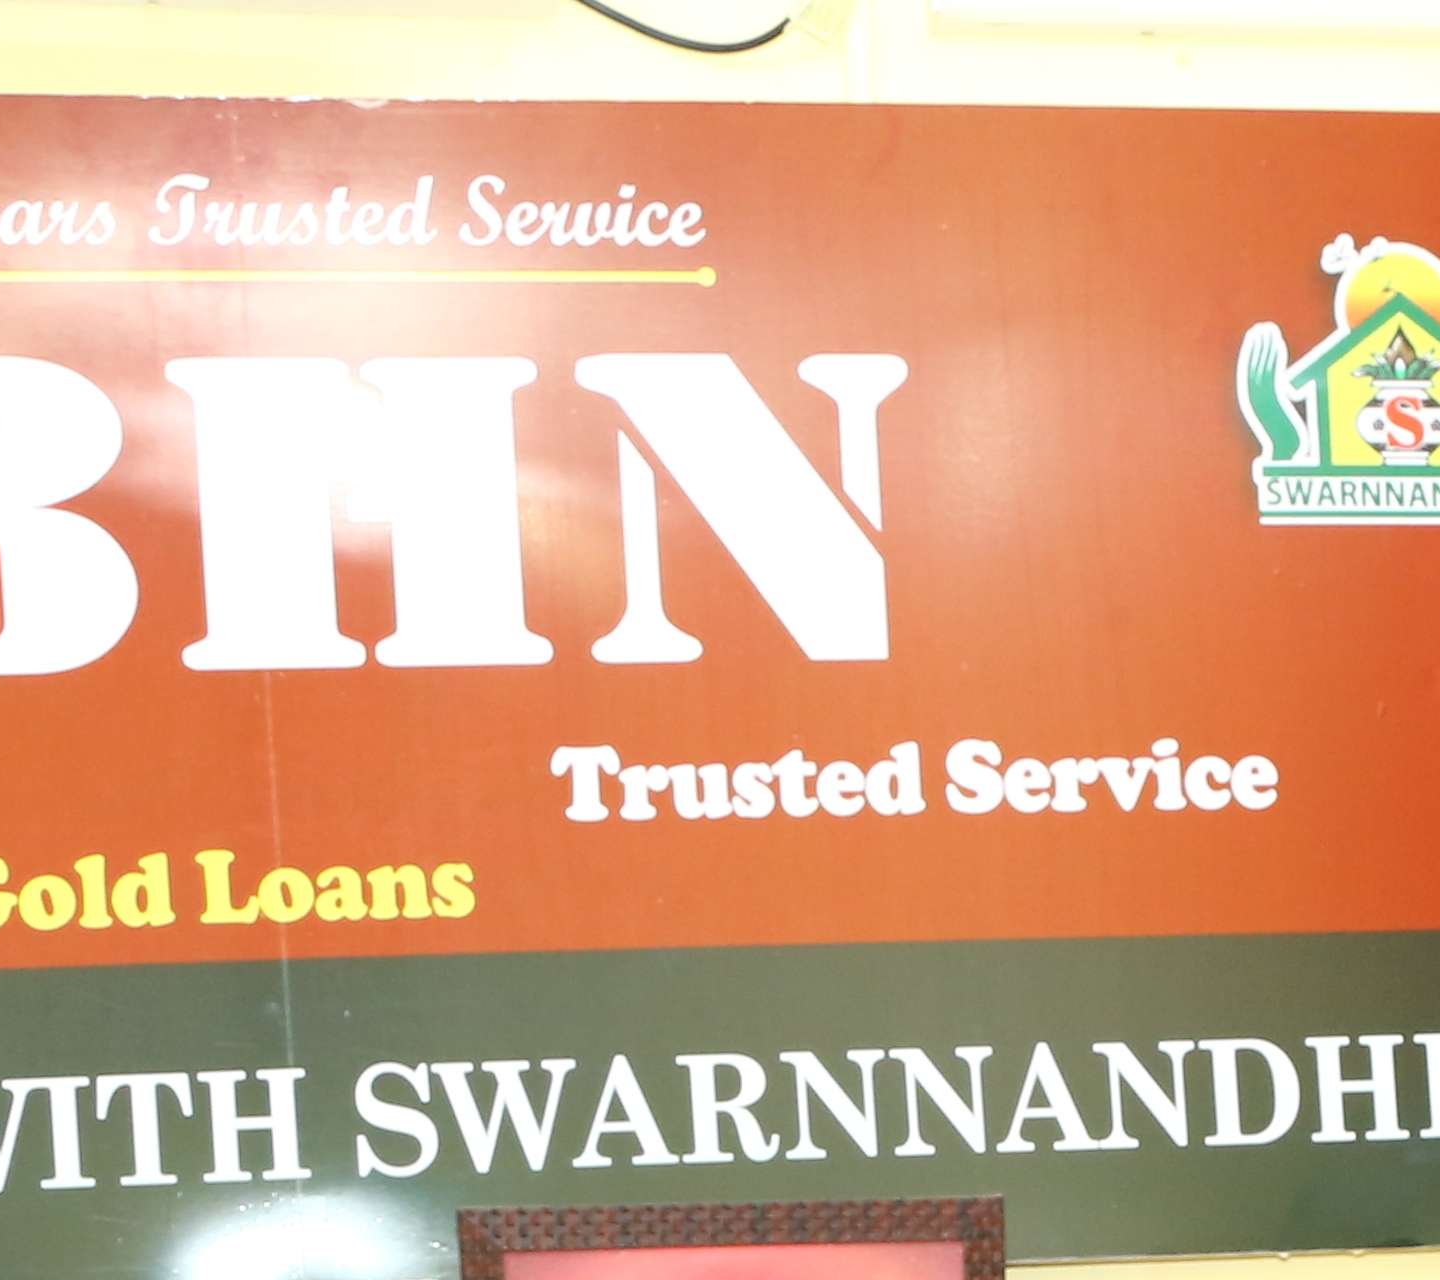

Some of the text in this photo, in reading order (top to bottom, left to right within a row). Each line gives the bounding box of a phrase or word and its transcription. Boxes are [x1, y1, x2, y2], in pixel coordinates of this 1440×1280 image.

[152, 173, 437, 248] Trusted
[457, 174, 707, 250] Service
[550, 738, 1279, 823] Trusted Service
[196, 849, 476, 925] Loans
